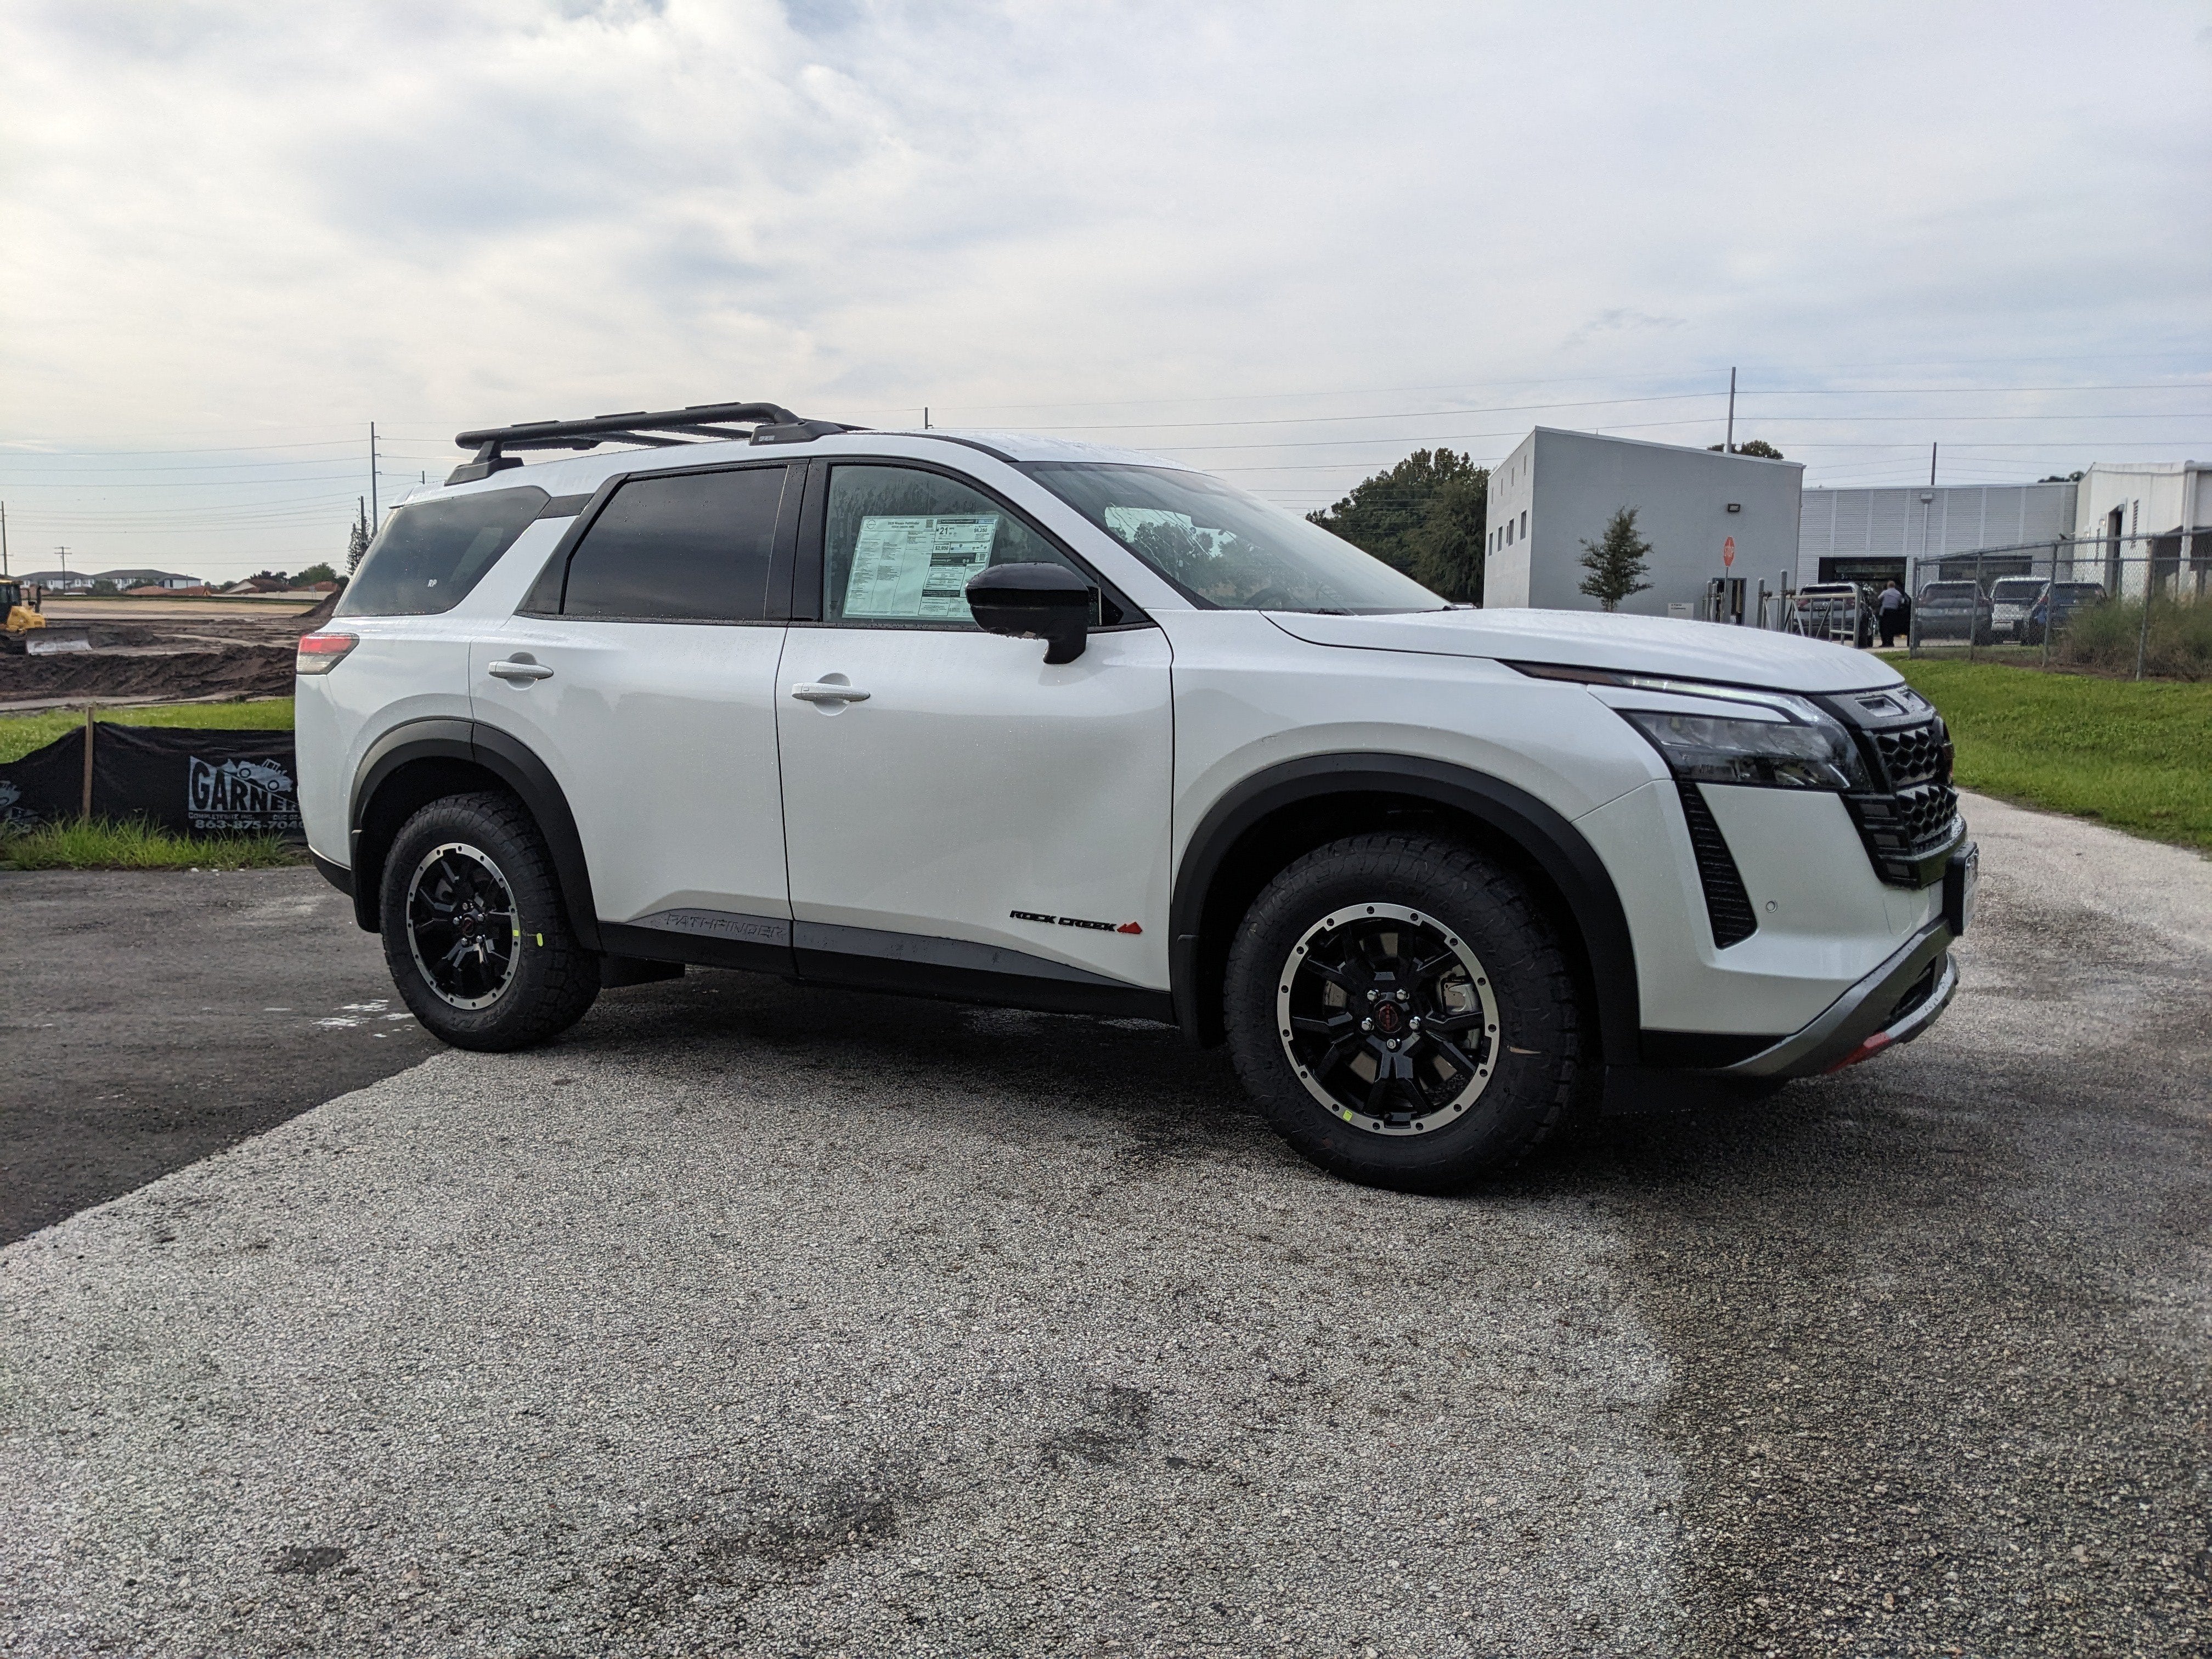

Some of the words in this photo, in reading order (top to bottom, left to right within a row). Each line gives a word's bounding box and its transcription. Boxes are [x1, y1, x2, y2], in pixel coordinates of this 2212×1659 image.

[1724, 546, 1734, 557] STOP
[666, 913, 786, 940] PATHFINDER
[1009, 910, 1057, 924] ROCK
[1058, 917, 1117, 932] CREEK
